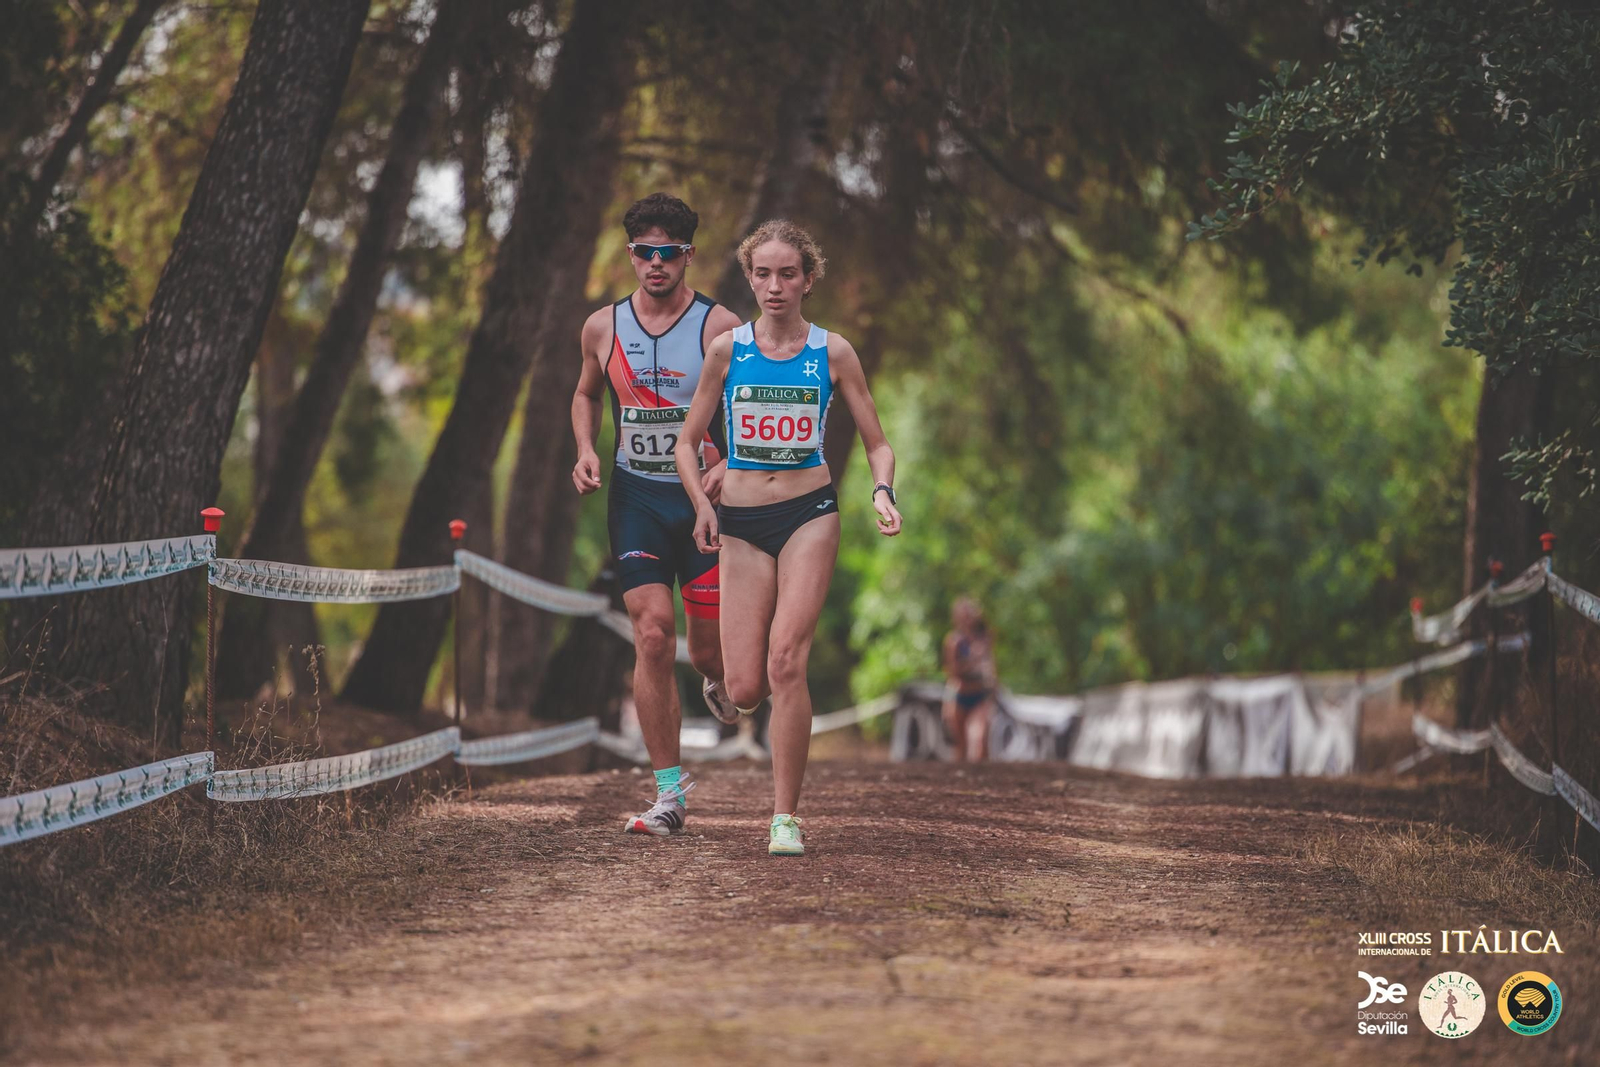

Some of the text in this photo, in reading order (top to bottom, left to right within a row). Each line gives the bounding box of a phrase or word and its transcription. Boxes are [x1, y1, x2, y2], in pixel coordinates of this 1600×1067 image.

[757, 387, 799, 399] ITÁLICA
[641, 409, 679, 420] ITÁLICA
[741, 414, 813, 442] 5609
[630, 433, 678, 456] 612
[661, 464, 676, 472] FA
